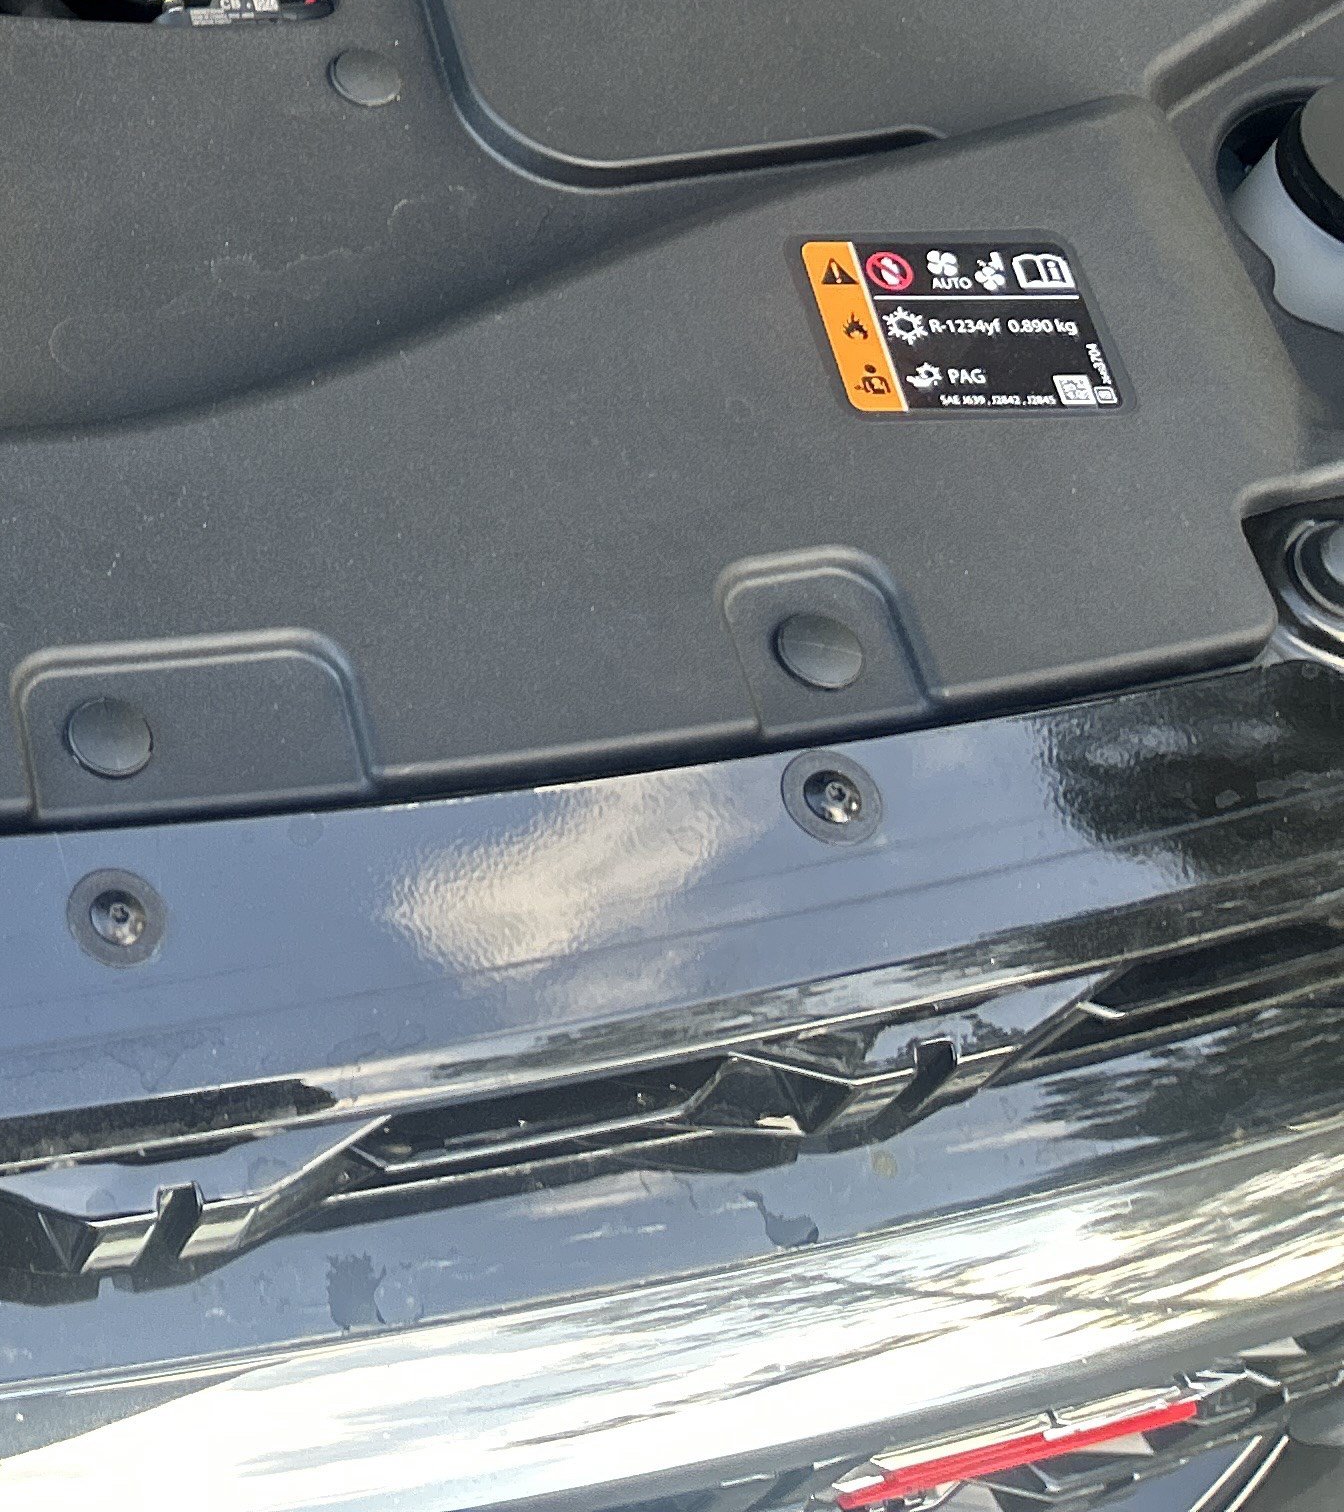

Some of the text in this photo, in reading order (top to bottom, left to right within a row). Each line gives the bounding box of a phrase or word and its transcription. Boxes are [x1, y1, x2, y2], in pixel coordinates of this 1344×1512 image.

[932, 276, 973, 290] AUTO
[928, 317, 1080, 337] R-1234yf 0.890 kg
[947, 368, 987, 385] PAG
[939, 394, 961, 406] SAE
